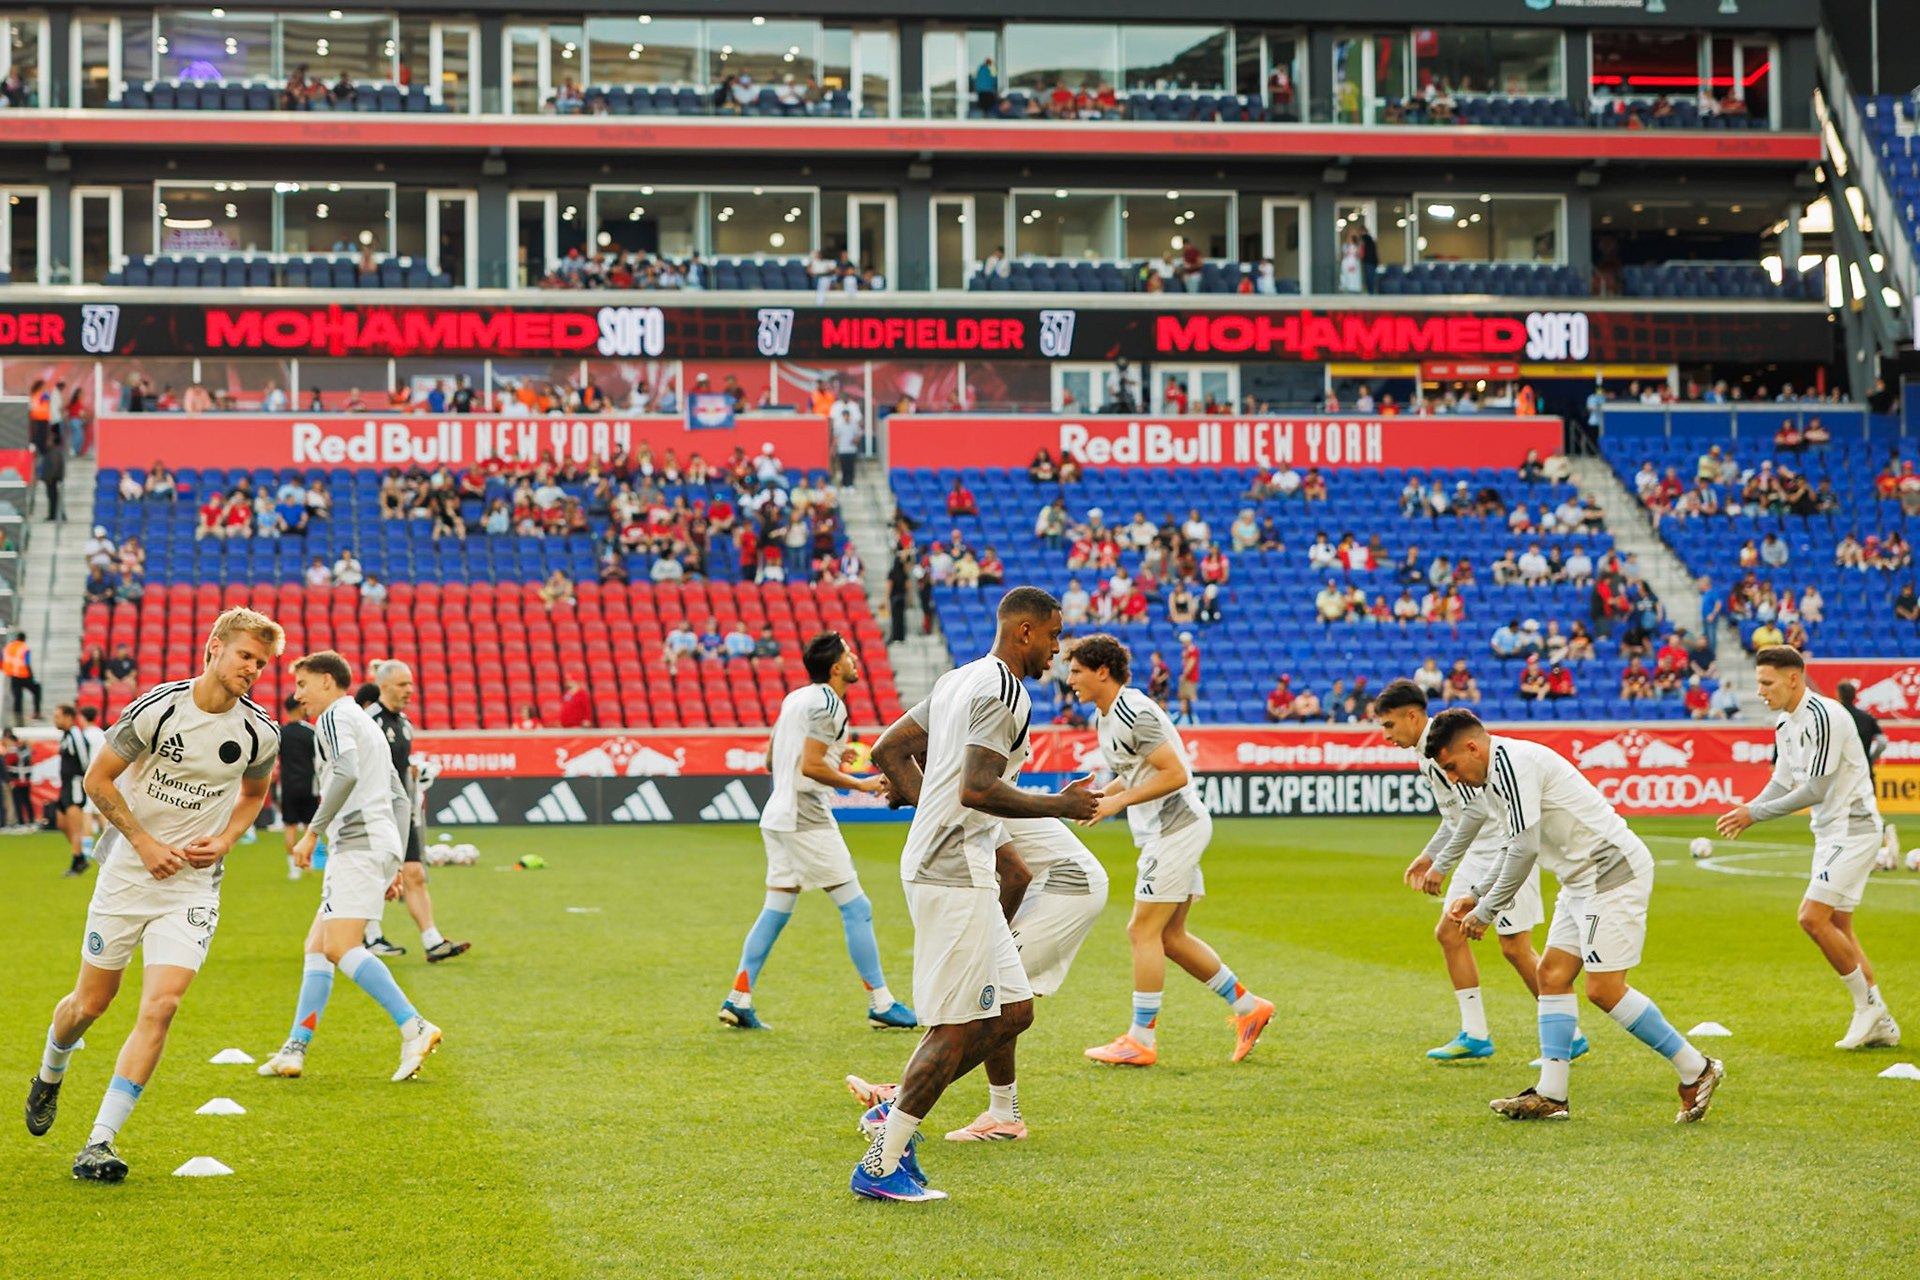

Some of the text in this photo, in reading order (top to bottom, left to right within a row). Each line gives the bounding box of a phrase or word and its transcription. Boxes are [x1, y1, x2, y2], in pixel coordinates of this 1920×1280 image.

[81, 304, 120, 353] 37
[206, 306, 664, 357] MOHAMMED SOFO
[757, 309, 795, 356] 37
[822, 318, 1024, 349] MIDFIELDER
[1040, 310, 1076, 357] 37
[1156, 311, 1589, 360] MOHAMMED SOFO
[292, 421, 377, 463] Red
[381, 421, 463, 463] Bull
[474, 422, 538, 463] NEW
[1059, 423, 1383, 464] Red Bull NEW YORK
[158, 744, 184, 764] 55
[146, 783, 202, 811] Einstein
[1249, 774, 1434, 815] EXPERIENCES
[1142, 856, 1158, 881] 2
[1824, 844, 1844, 867] 7
[1585, 914, 1601, 945] 7
